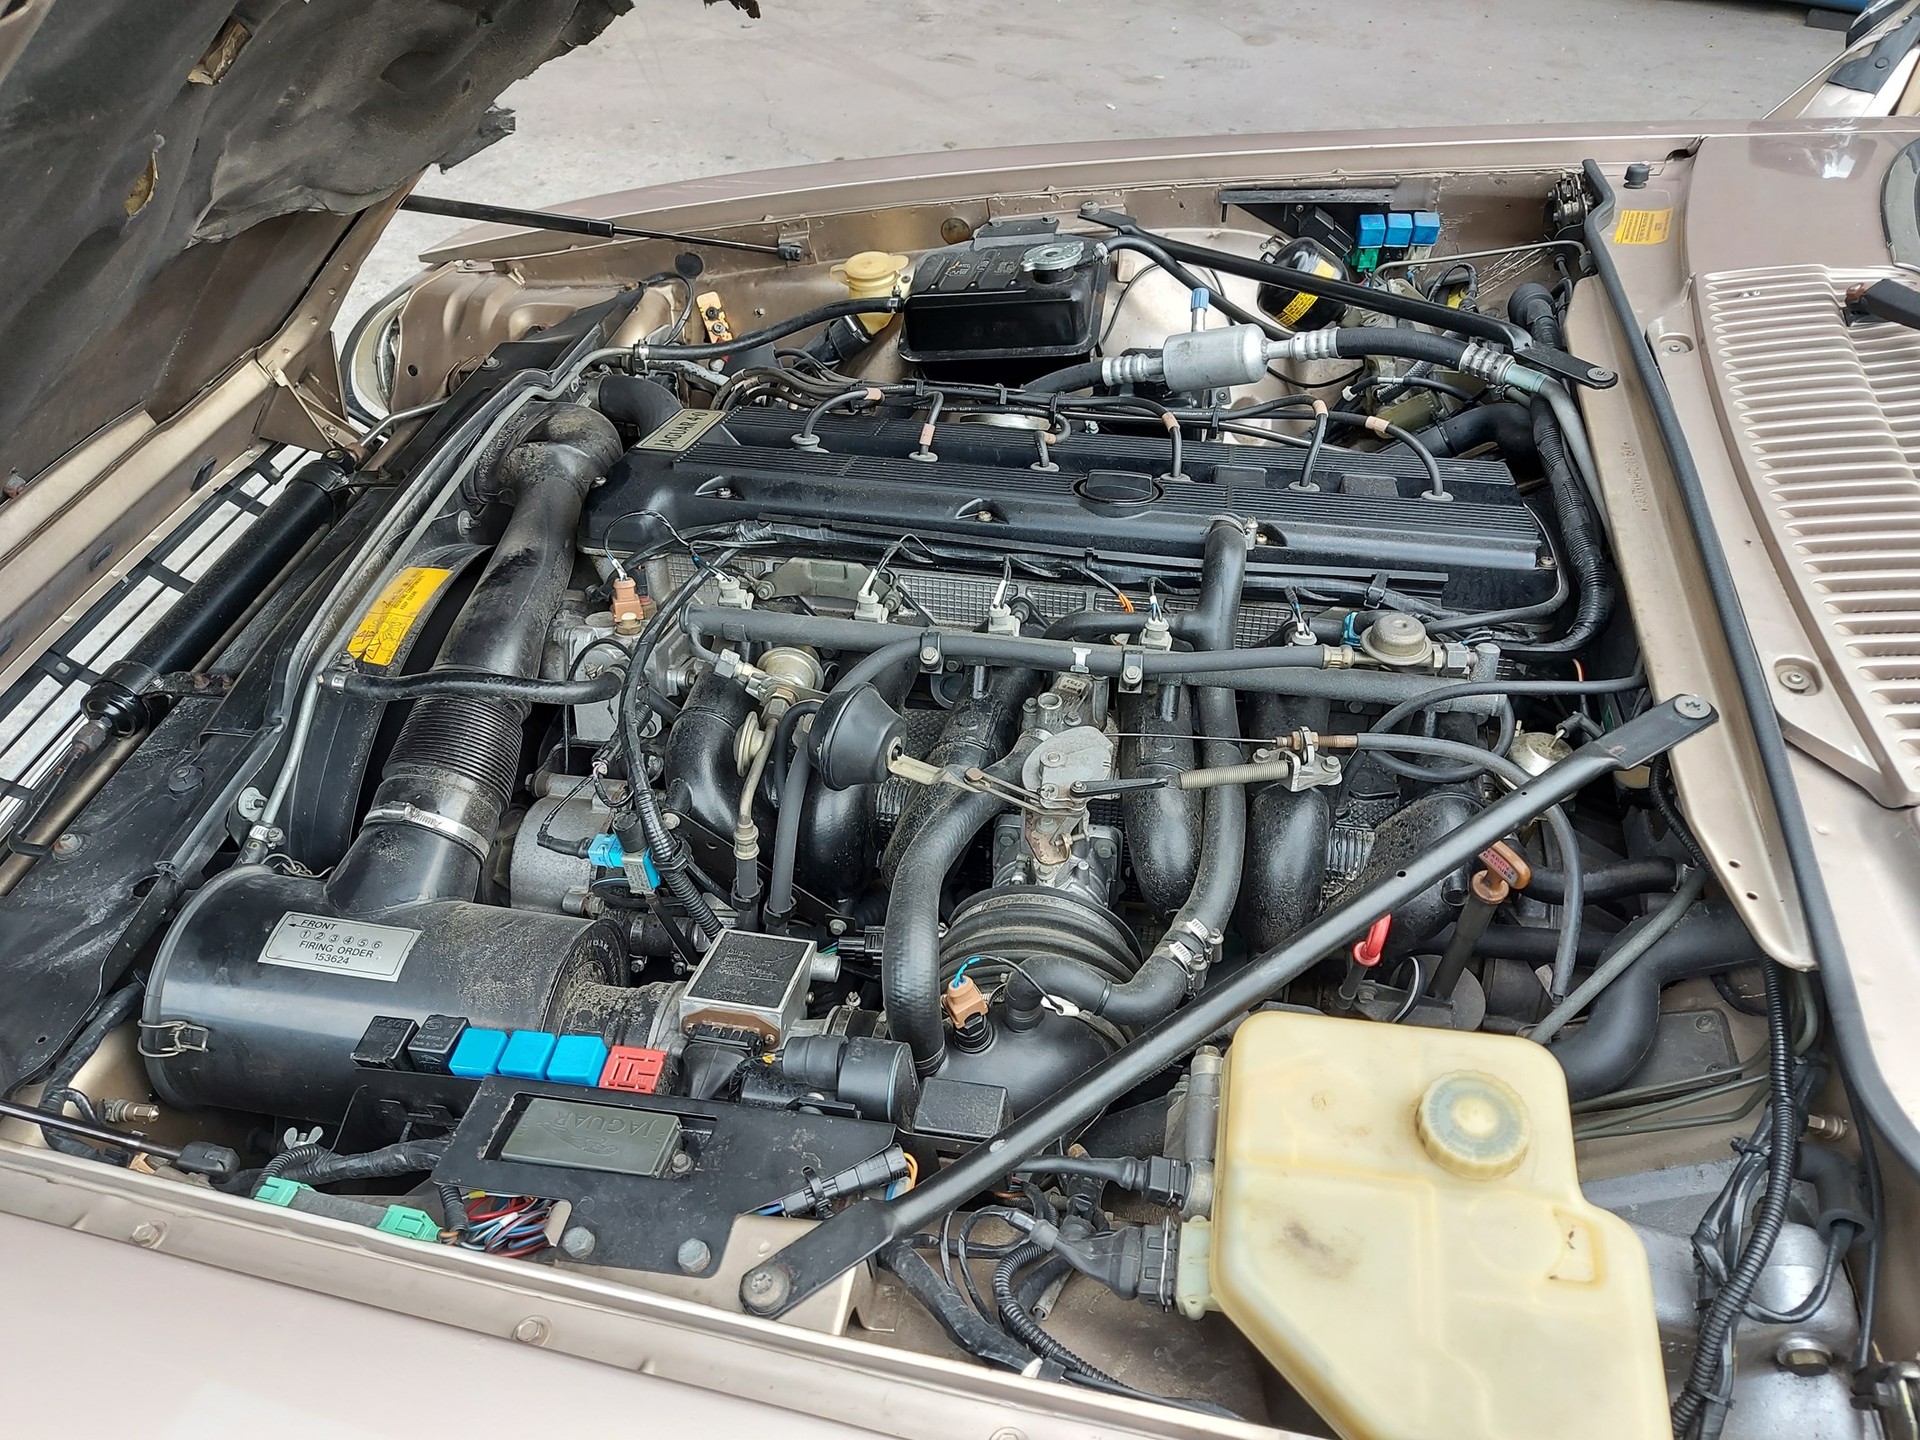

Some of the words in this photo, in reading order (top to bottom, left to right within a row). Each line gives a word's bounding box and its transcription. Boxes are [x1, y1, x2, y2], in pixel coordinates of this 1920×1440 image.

[654, 421, 697, 447] JAGUAR
[301, 919, 338, 930] FRONT
[299, 941, 334, 953] FIRING
[337, 946, 374, 958] ORDER
[314, 952, 350, 965] 153624
[556, 1110, 658, 1138] JAGUAR
